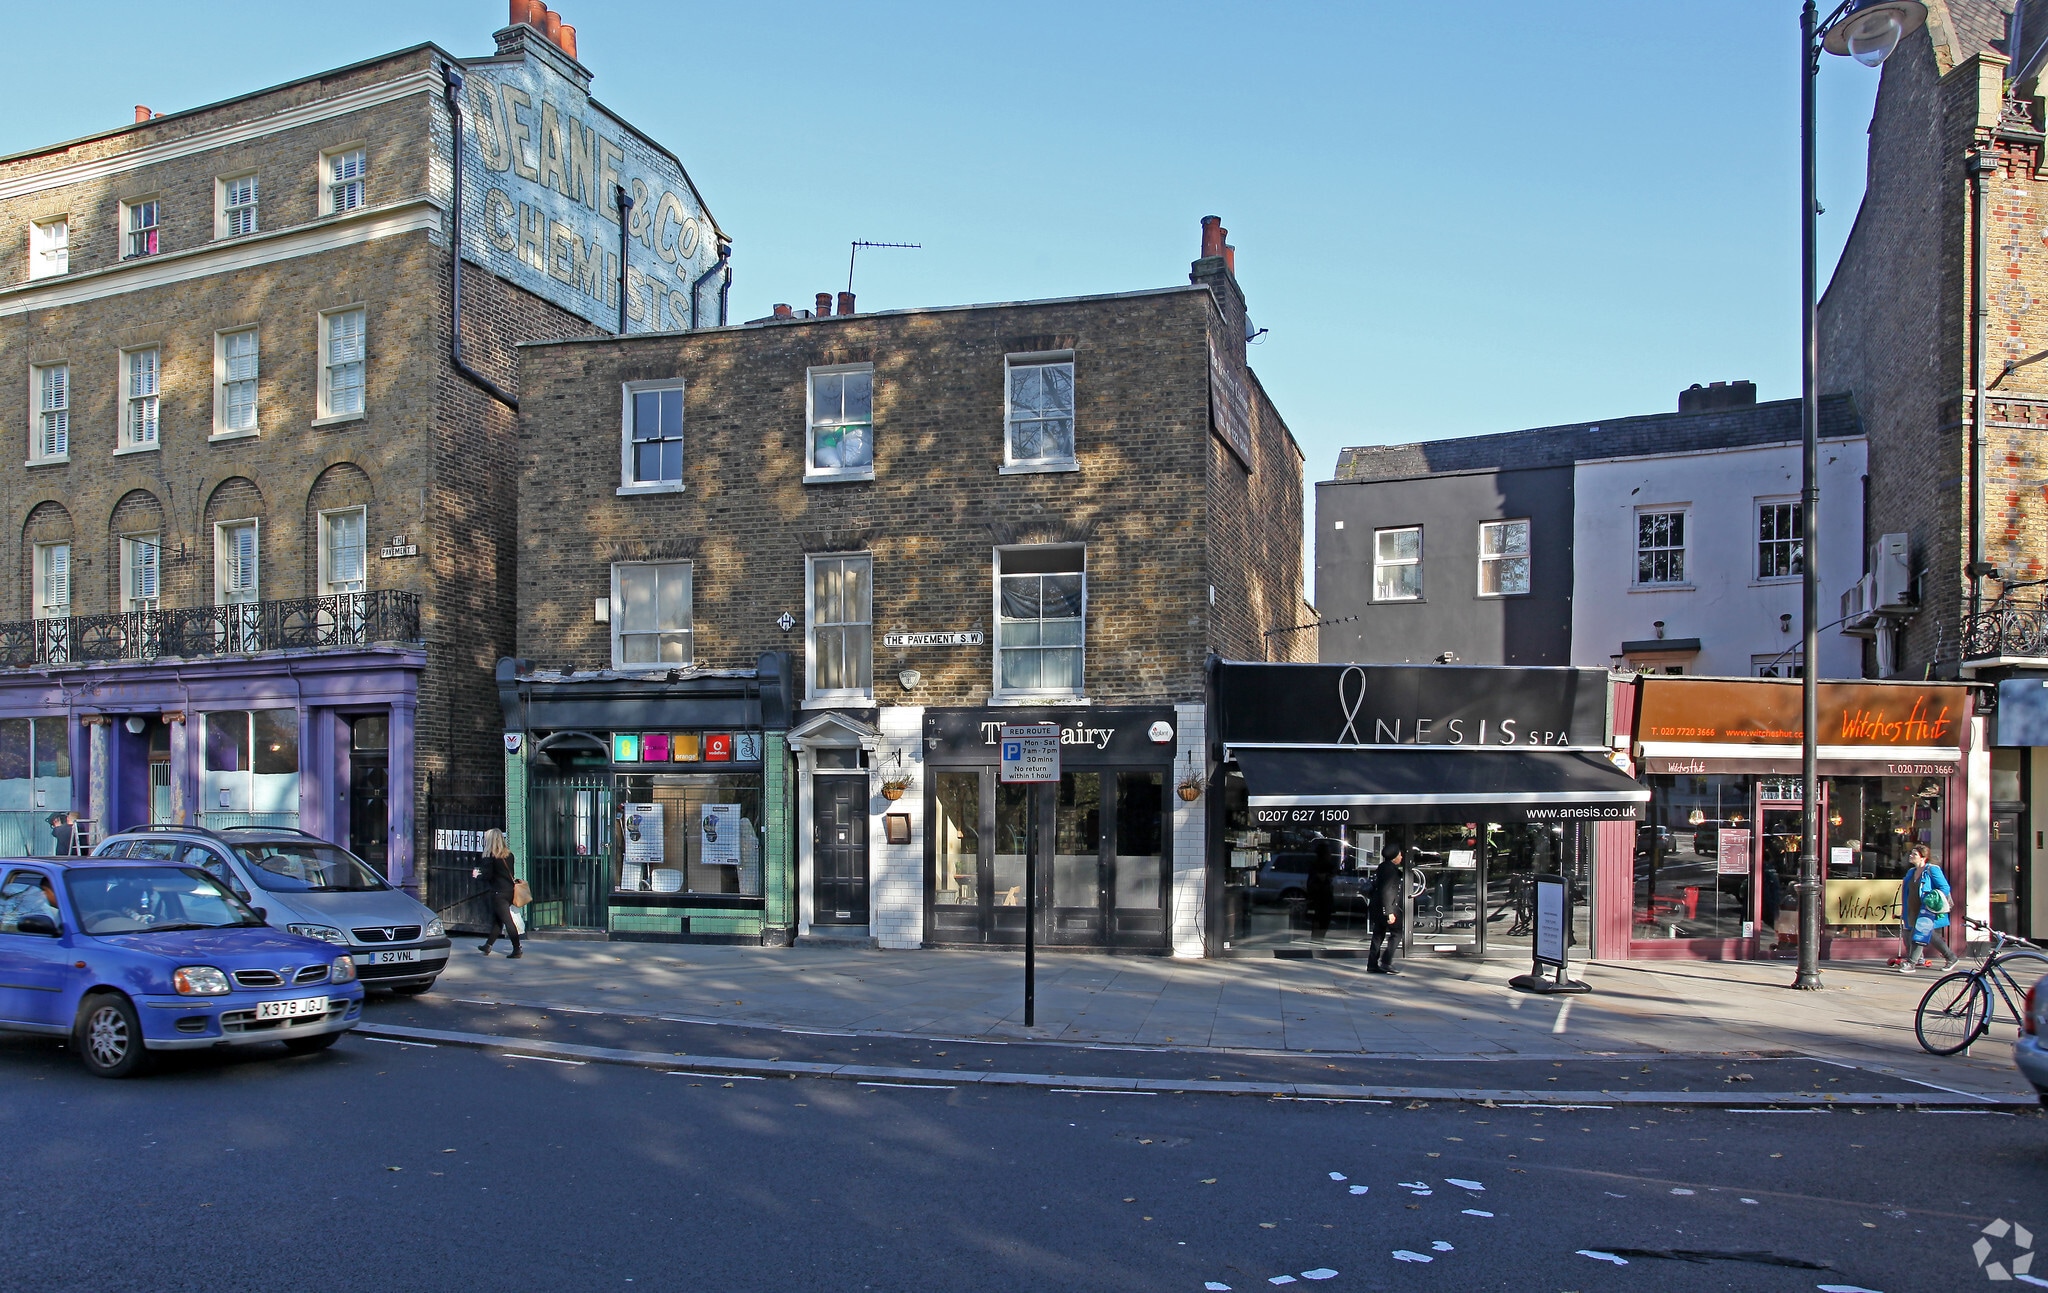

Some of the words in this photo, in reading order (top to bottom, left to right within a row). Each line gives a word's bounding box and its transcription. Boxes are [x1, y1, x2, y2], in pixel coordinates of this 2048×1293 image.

[465, 74, 624, 227] DEANE
[629, 177, 651, 248] &
[484, 187, 691, 333] CHEMISTS
[887, 636, 904, 644] THE
[908, 634, 955, 644] PAVEMENT
[1841, 709, 1902, 742] Witches
[1904, 695, 1951, 741] Hut
[1529, 731, 1569, 745] SPA
[1660, 727, 1674, 736] 020
[1676, 727, 1695, 736] 7720
[1696, 728, 1716, 737] 3666
[1007, 744, 1019, 760] P
[1898, 764, 1912, 774] 020
[1914, 764, 1934, 774] 7720
[1935, 765, 1954, 774] 3666
[1258, 810, 1288, 822] 0207
[1292, 810, 1316, 822] 627
[1320, 810, 1350, 821] 1500
[1526, 806, 1636, 818] www.anesis.co.uk
[1838, 894, 1888, 922] Witches
[382, 952, 394, 962] S2
[396, 952, 414, 962] VNL
[262, 1002, 297, 1016] X379
[301, 999, 324, 1012] JGJ
